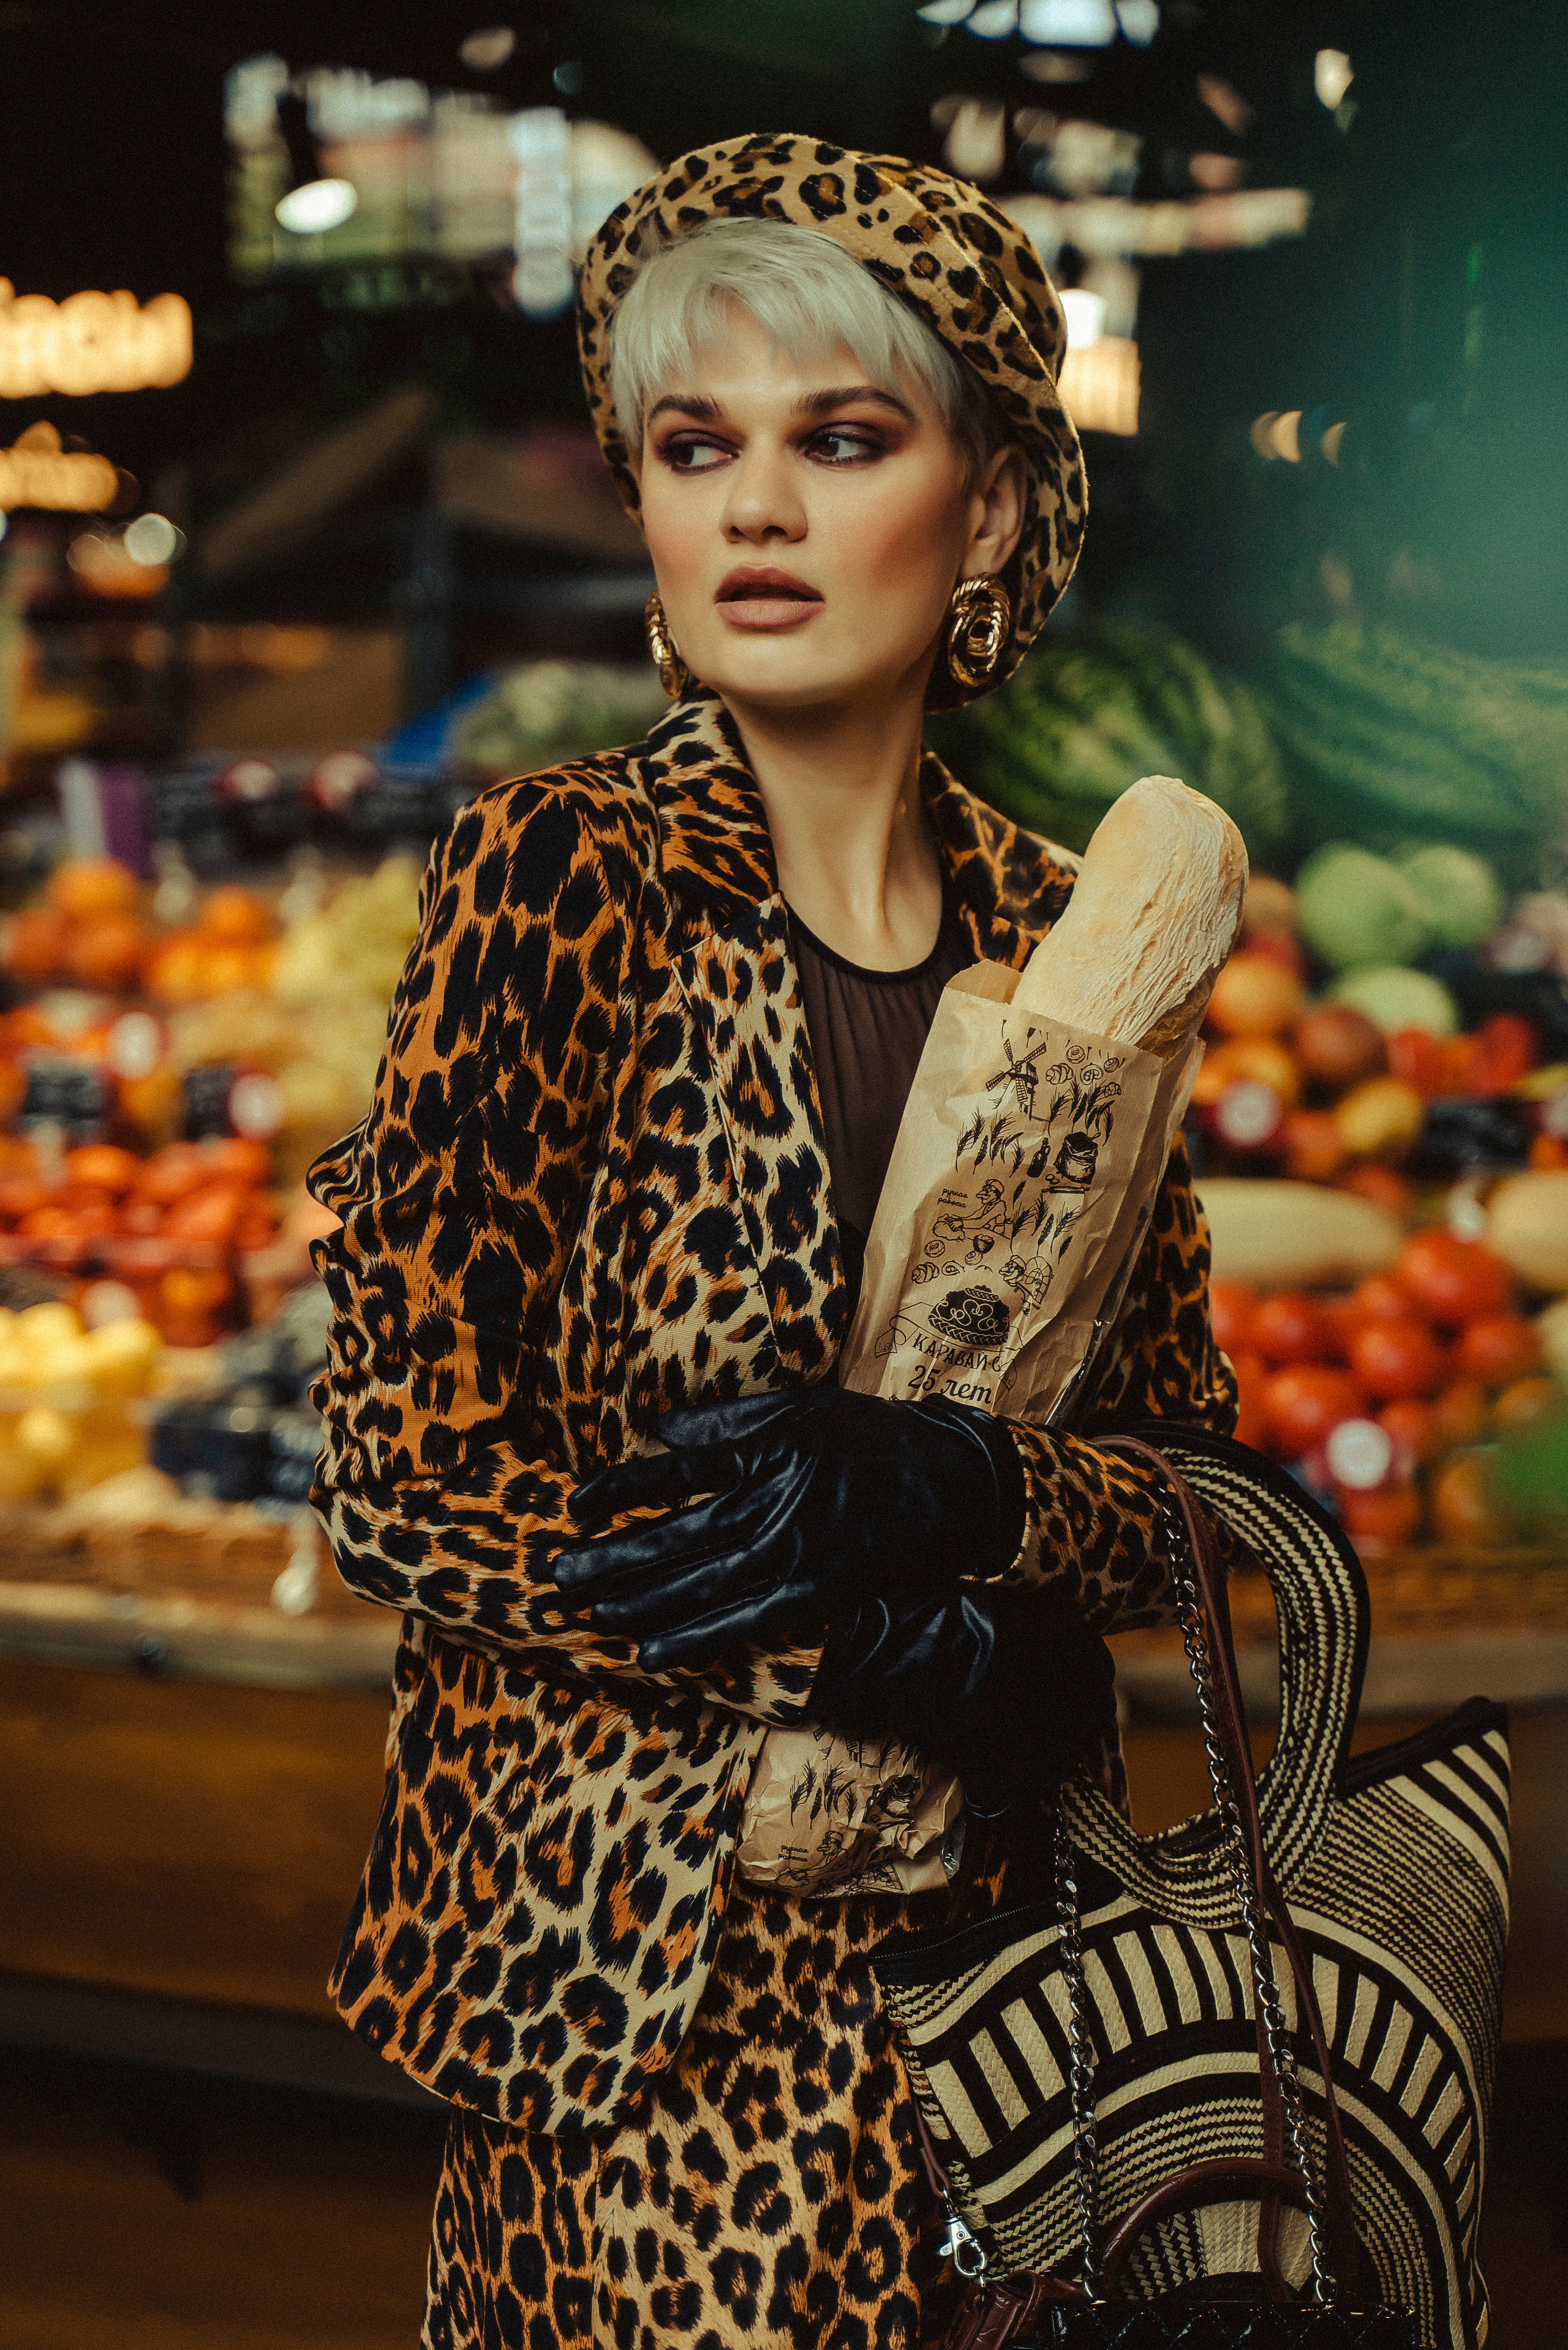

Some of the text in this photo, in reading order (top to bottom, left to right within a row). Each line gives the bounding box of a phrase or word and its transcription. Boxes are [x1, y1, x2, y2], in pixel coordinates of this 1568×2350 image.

[941, 1188, 969, 1199] ручная
[937, 1197, 967, 1208] работа
[907, 1365, 993, 1404] 25 лет
